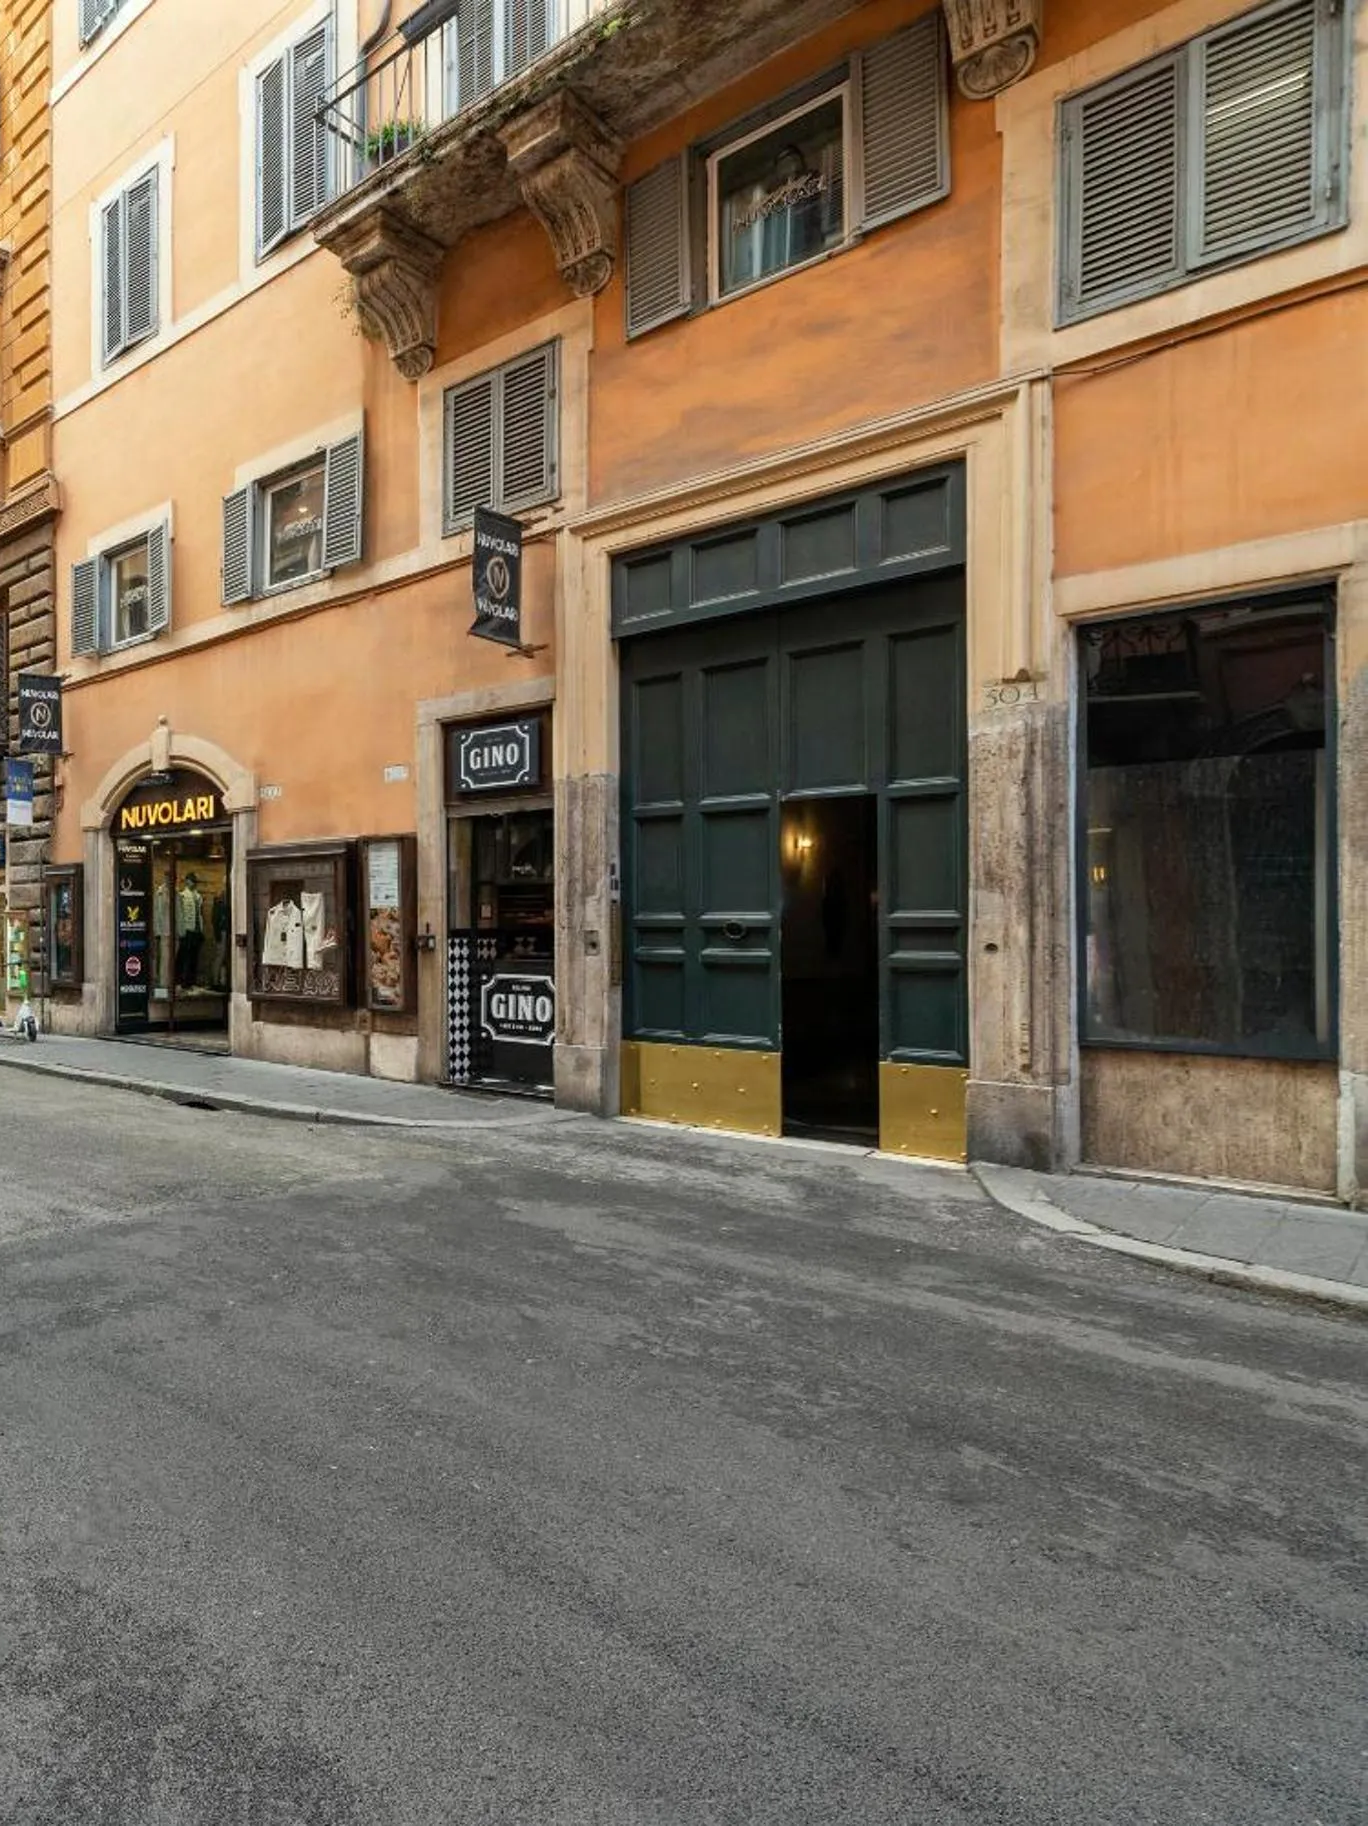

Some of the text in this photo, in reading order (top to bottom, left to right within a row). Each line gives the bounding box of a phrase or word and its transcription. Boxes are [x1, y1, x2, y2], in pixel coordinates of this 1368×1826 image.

[469, 743, 519, 771] GINO
[121, 795, 215, 830] NUVOLARI
[491, 993, 553, 1023] GINO
